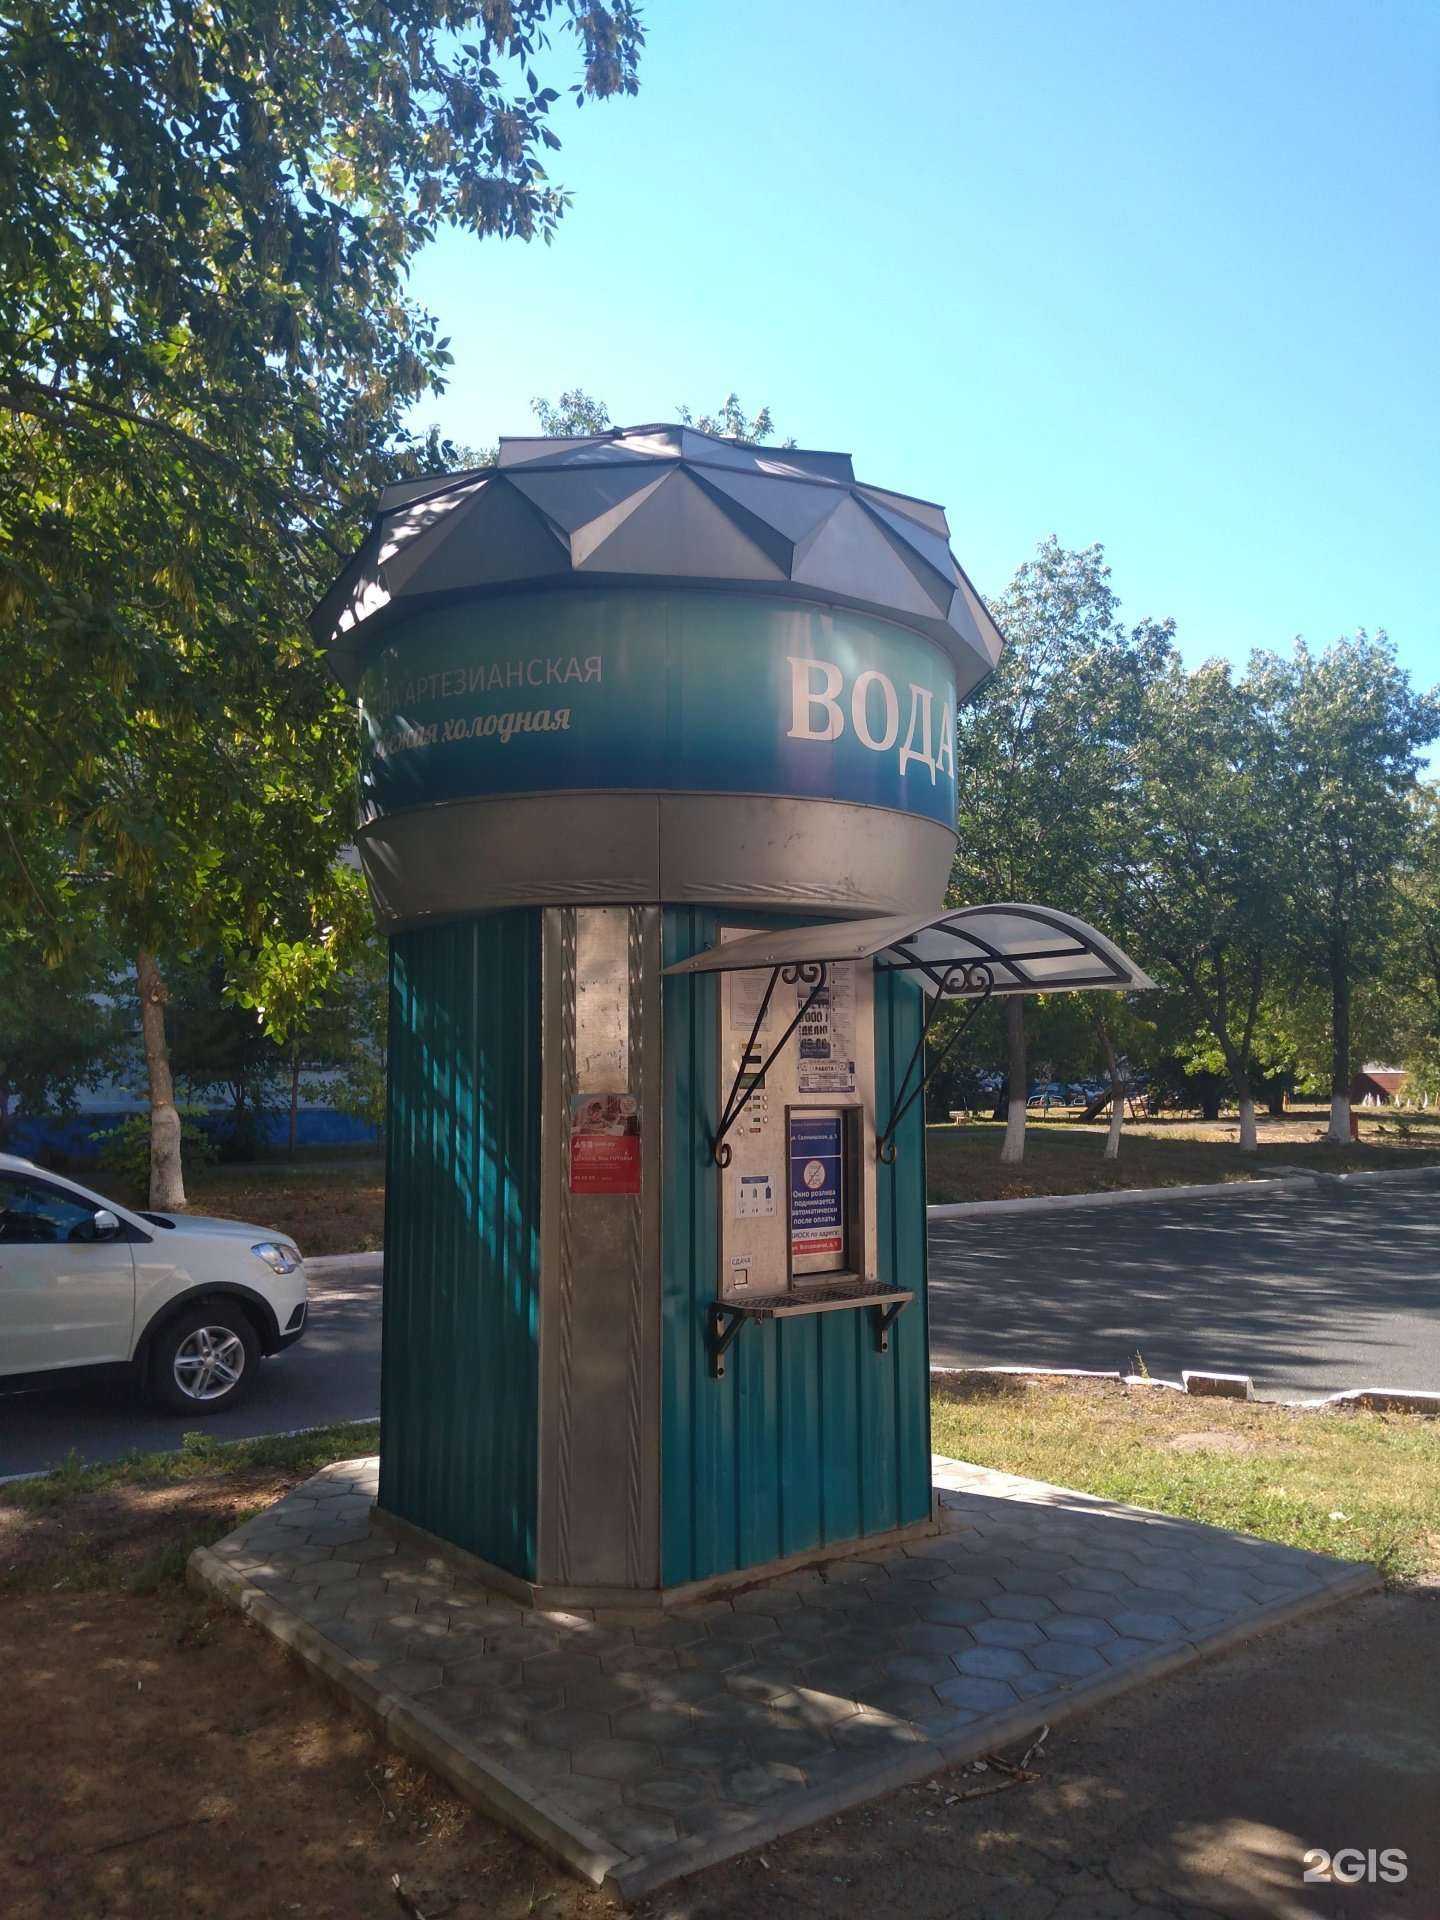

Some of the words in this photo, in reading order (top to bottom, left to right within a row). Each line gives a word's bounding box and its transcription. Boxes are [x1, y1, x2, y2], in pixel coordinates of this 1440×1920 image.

[405, 655, 603, 705] АРТЕЗИАНСКАЯ
[441, 705, 573, 744] холодная
[785, 656, 955, 786] ВОДА
[792, 1190, 810, 1198] Окно
[793, 1217, 812, 1225] после
